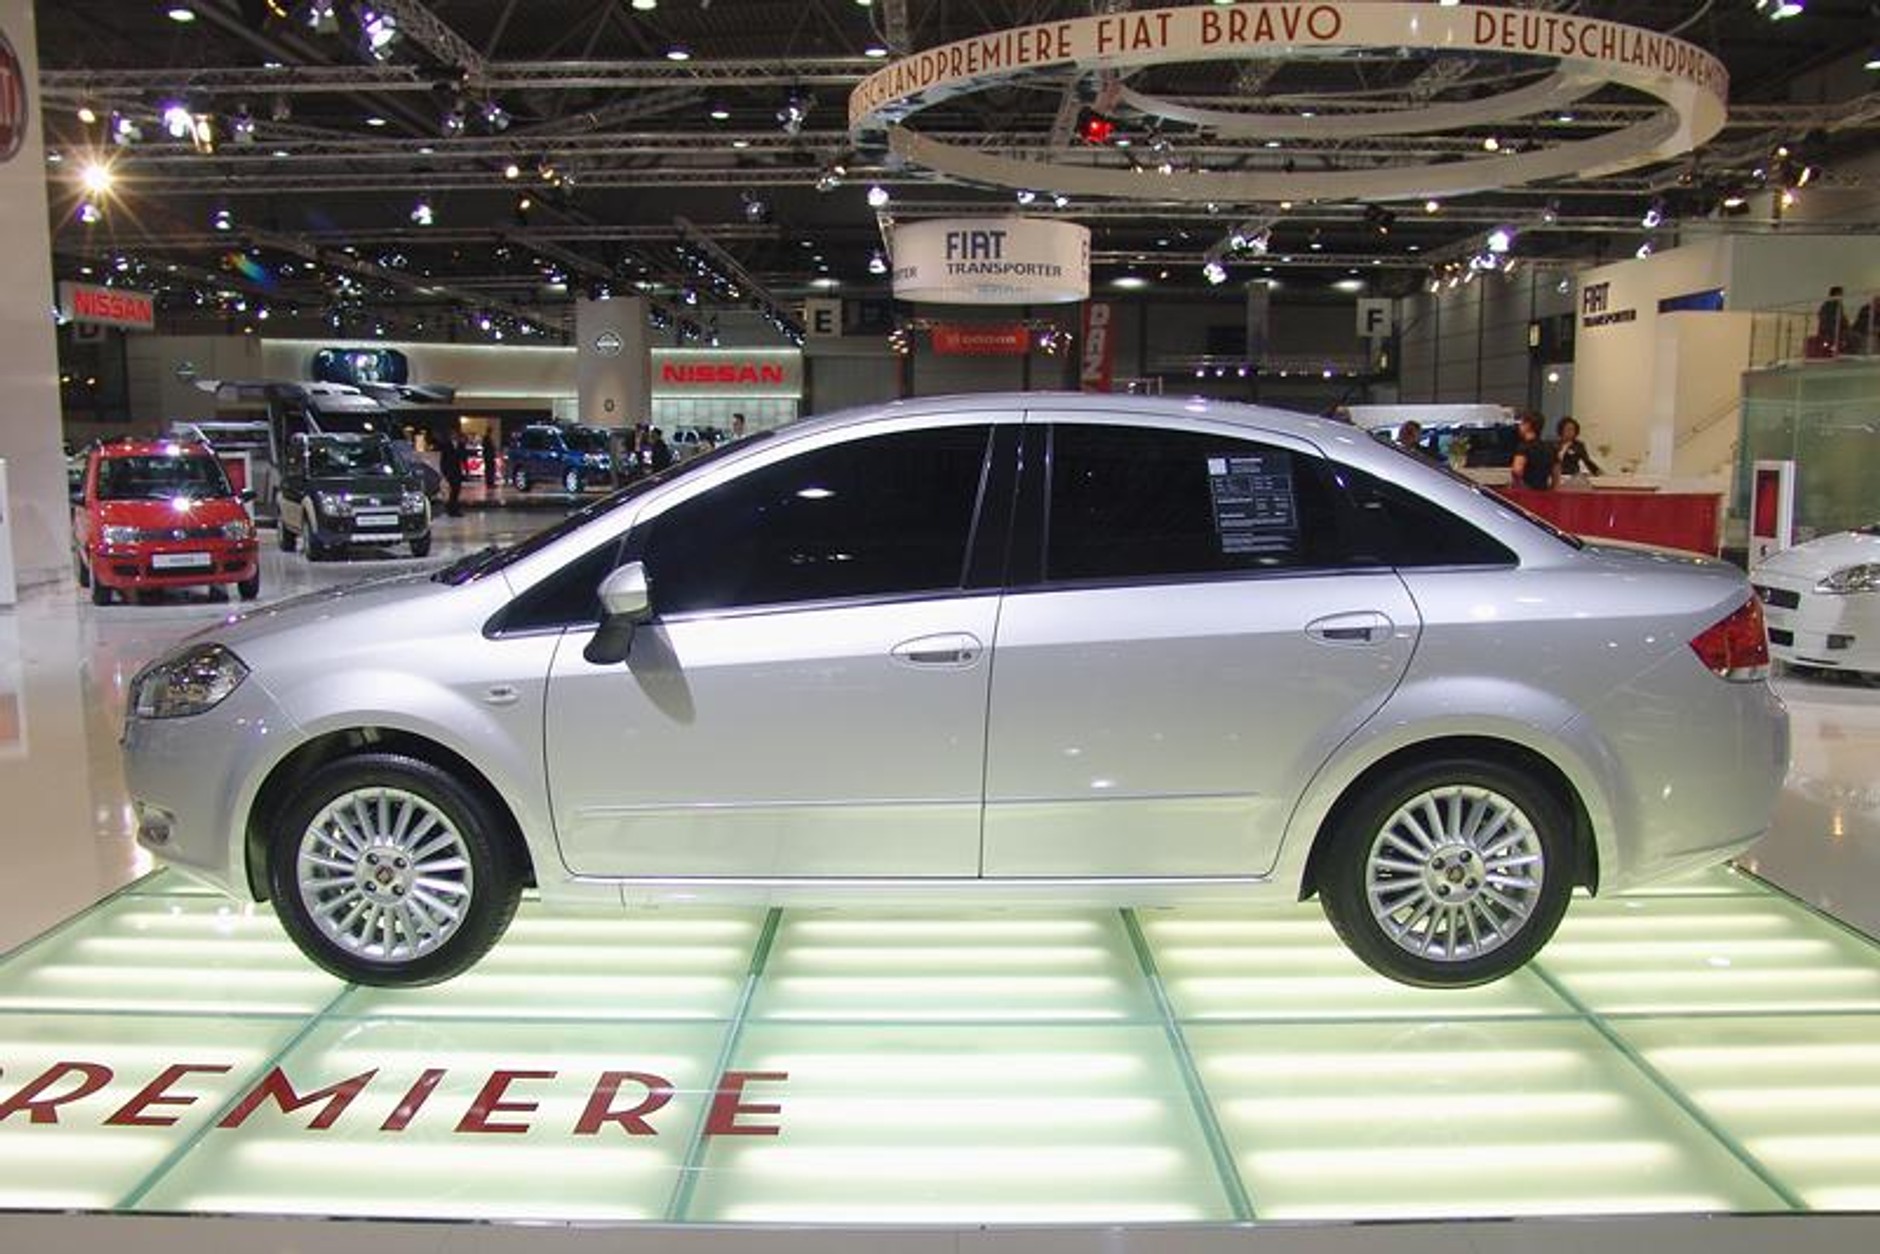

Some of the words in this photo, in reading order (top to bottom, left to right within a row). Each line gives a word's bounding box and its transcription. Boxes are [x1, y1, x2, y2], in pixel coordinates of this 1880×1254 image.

[1097, 13, 1173, 54] FIAT
[1202, 5, 1342, 44] BRAVO
[946, 230, 1006, 260] FIAT
[946, 262, 1062, 278] TRANSPORTER
[74, 288, 152, 322] NISSAN
[1582, 281, 1610, 315] FIAT
[815, 309, 832, 333] E
[1367, 309, 1383, 333] F
[661, 362, 784, 384] NISSAN
[0, 1061, 789, 1136] REMIERE
